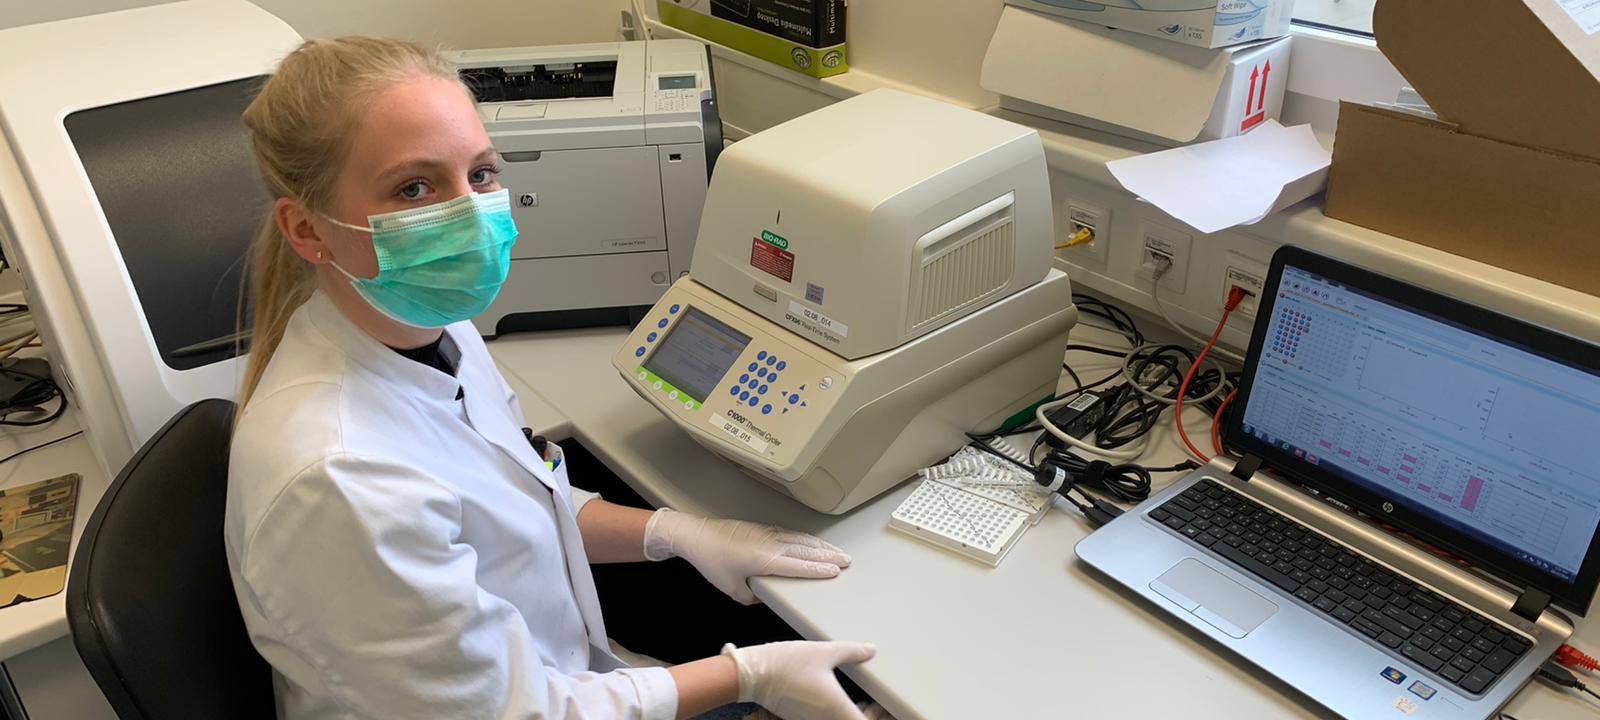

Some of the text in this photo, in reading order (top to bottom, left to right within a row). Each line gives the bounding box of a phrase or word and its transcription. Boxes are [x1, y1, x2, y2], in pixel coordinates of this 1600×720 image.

[781, 20, 812, 36] Multimedia
[763, 232, 787, 248] BIO-RAD
[746, 421, 767, 438] Thermal
[764, 432, 782, 447] Cycler
